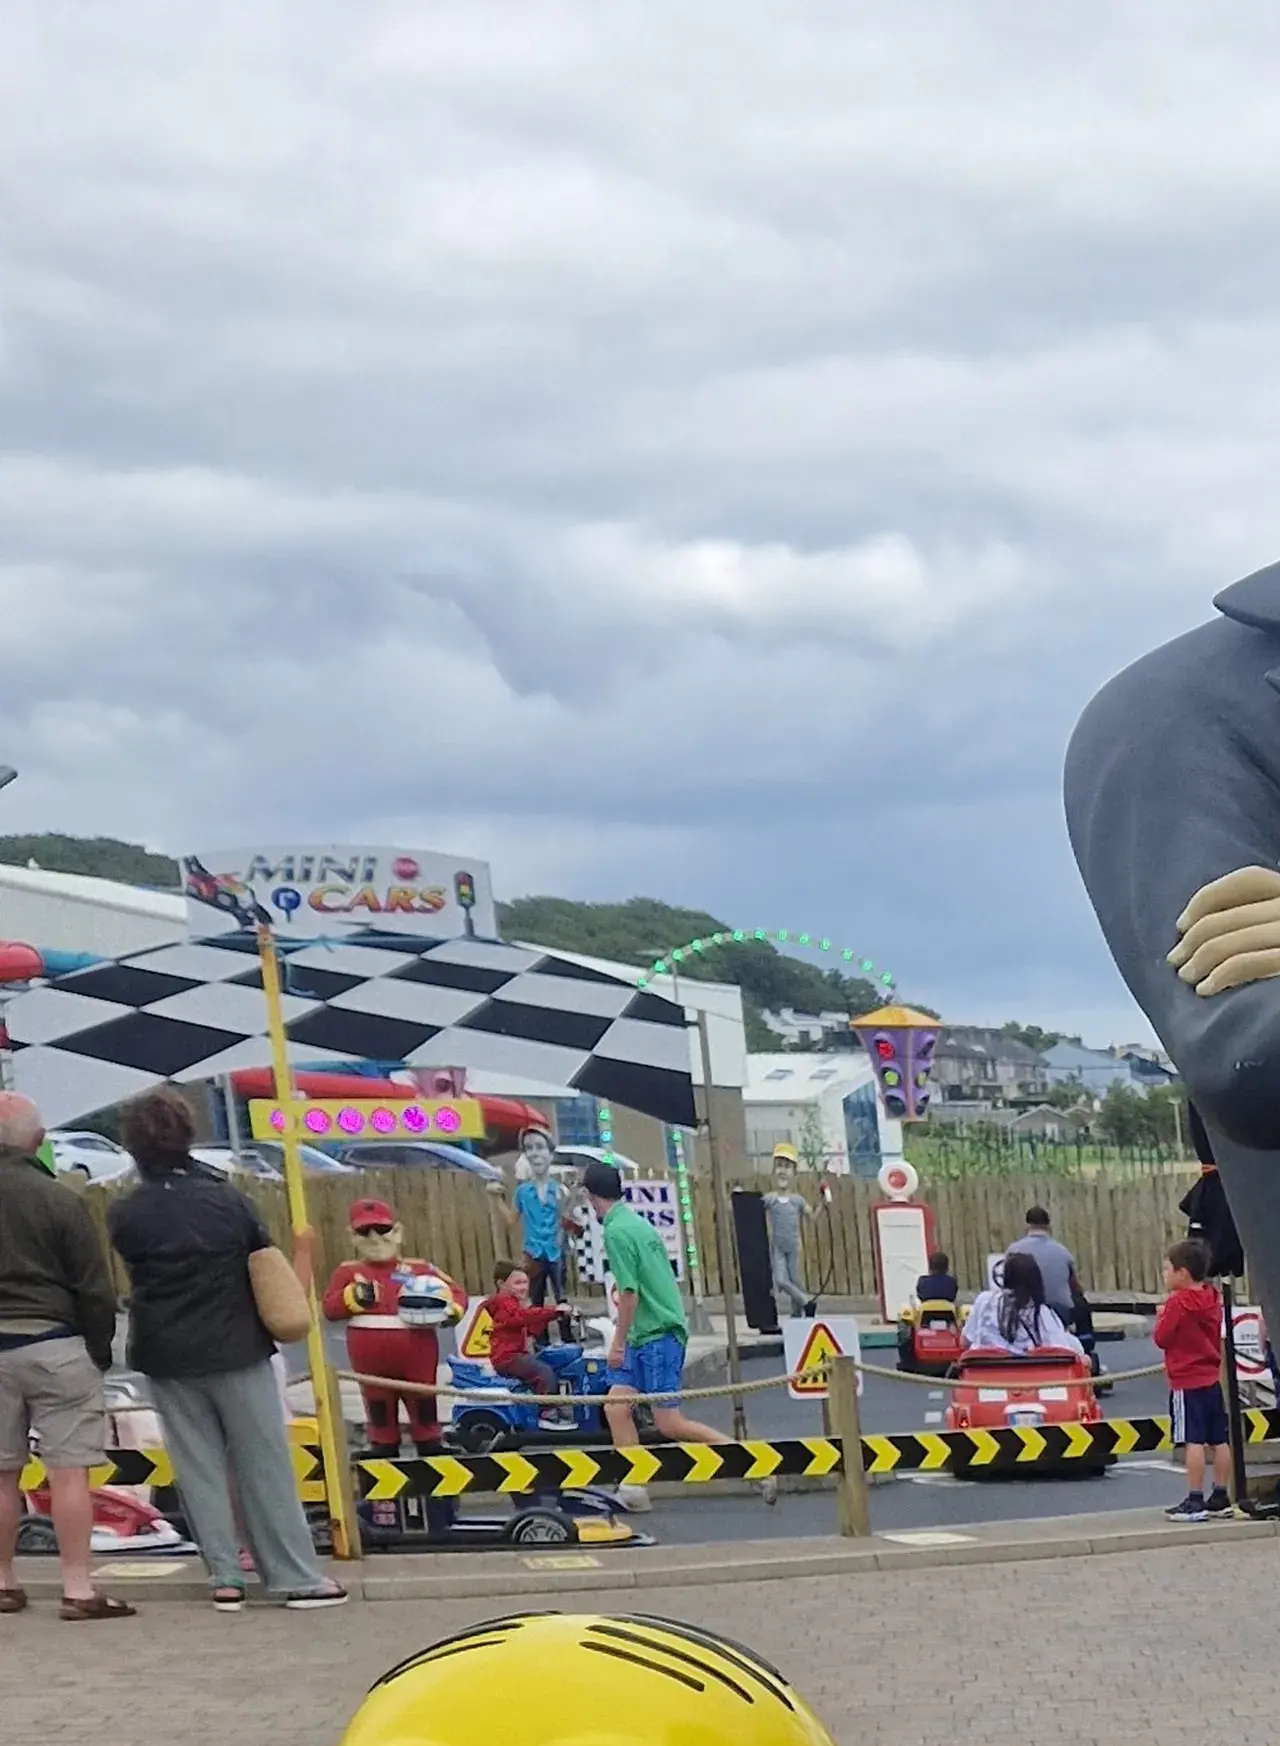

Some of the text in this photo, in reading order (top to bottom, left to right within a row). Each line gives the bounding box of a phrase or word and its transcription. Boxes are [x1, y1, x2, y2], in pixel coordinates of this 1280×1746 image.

[245, 855, 378, 883] MINI
[307, 884, 447, 914] CARS
[623, 1187, 670, 1203] INI
